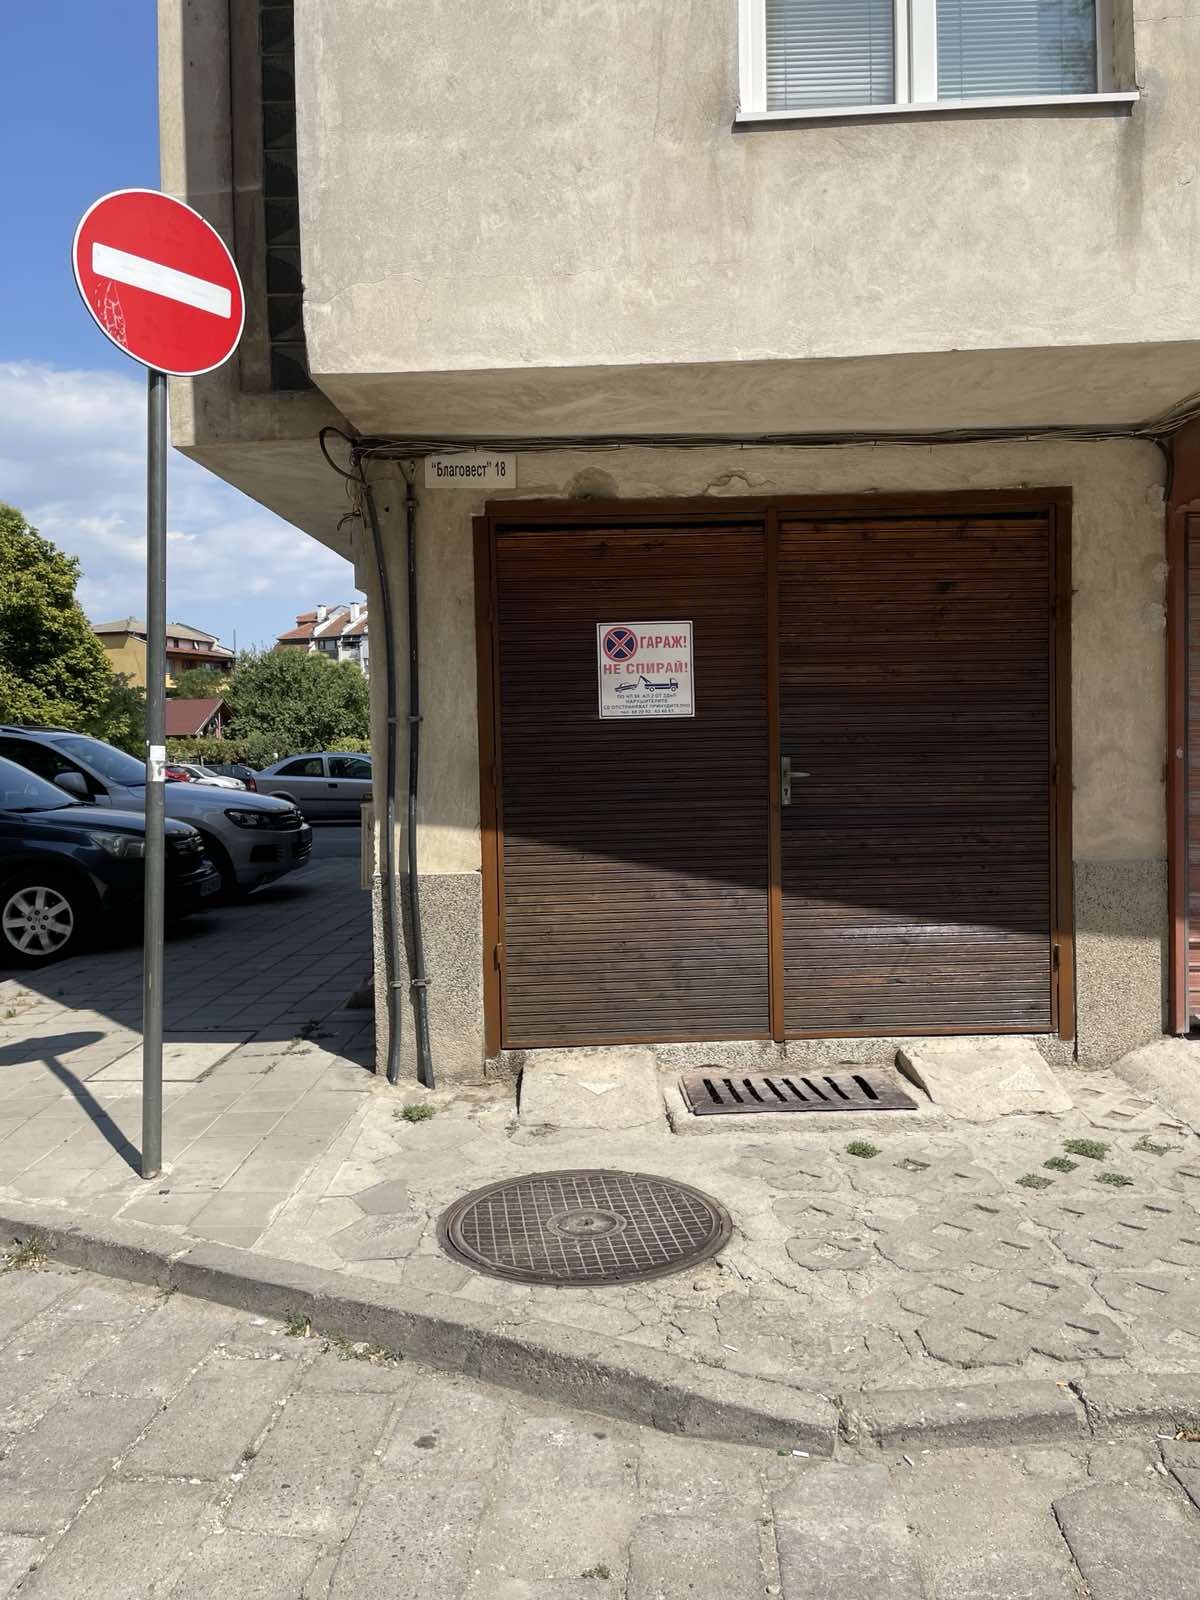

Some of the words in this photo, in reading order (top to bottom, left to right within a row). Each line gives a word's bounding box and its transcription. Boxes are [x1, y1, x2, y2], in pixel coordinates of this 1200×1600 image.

[494, 461, 506, 477] 18
[640, 635, 687, 649] ГАРАЖ!
[603, 663, 621, 675] НЕ
[626, 660, 688, 675] СПИРАЙ!
